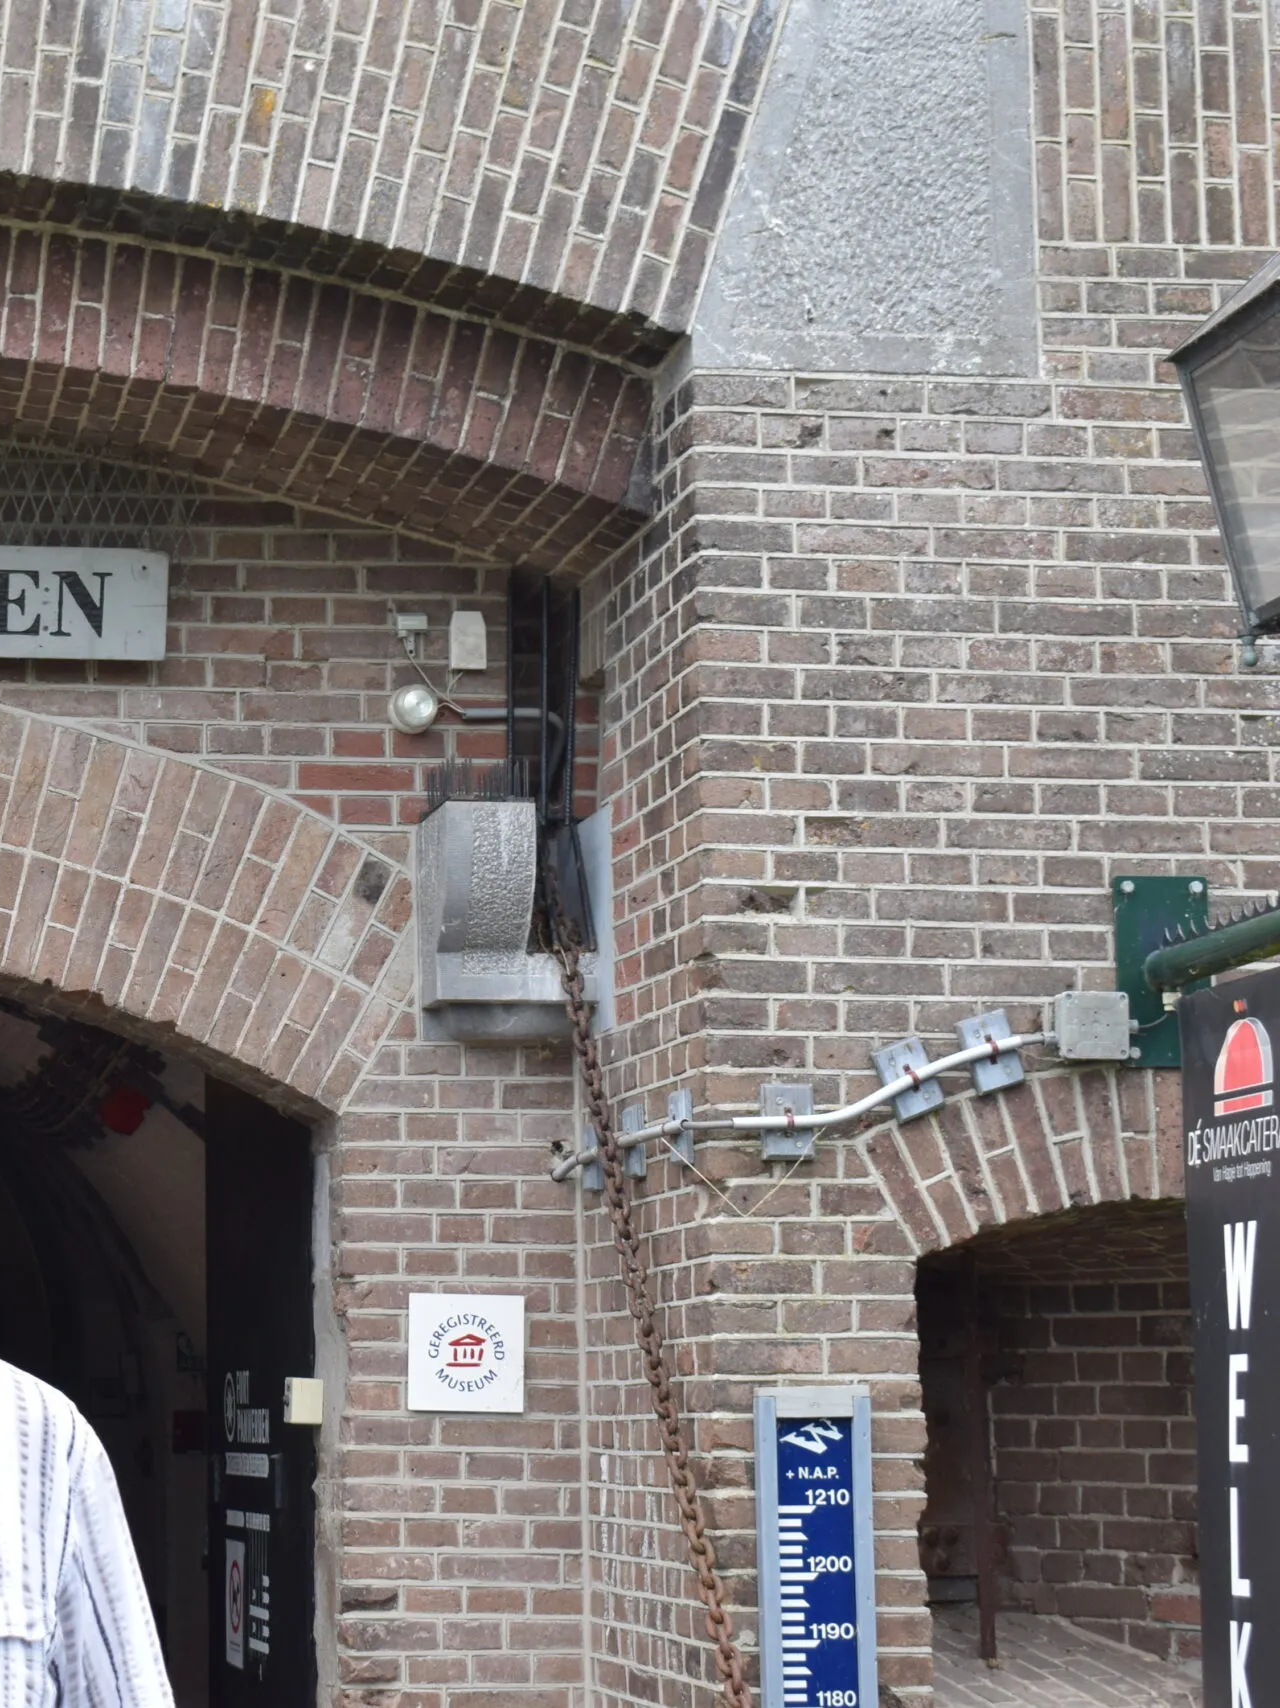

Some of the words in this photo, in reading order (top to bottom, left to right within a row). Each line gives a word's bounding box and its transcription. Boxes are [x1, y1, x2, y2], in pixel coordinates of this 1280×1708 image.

[1187, 1118, 1202, 1166] DÉ
[1203, 1115, 1280, 1162] SMAAKCATER
[428, 1313, 505, 1361] GEREGISTREERD
[435, 1368, 498, 1393] MUSEUM
[798, 1466, 840, 1479] N.A.P.
[805, 1488, 850, 1506] 1210
[807, 1555, 852, 1573] 1200
[809, 1622, 854, 1640] 1190
[816, 1690, 857, 1707] 1180
